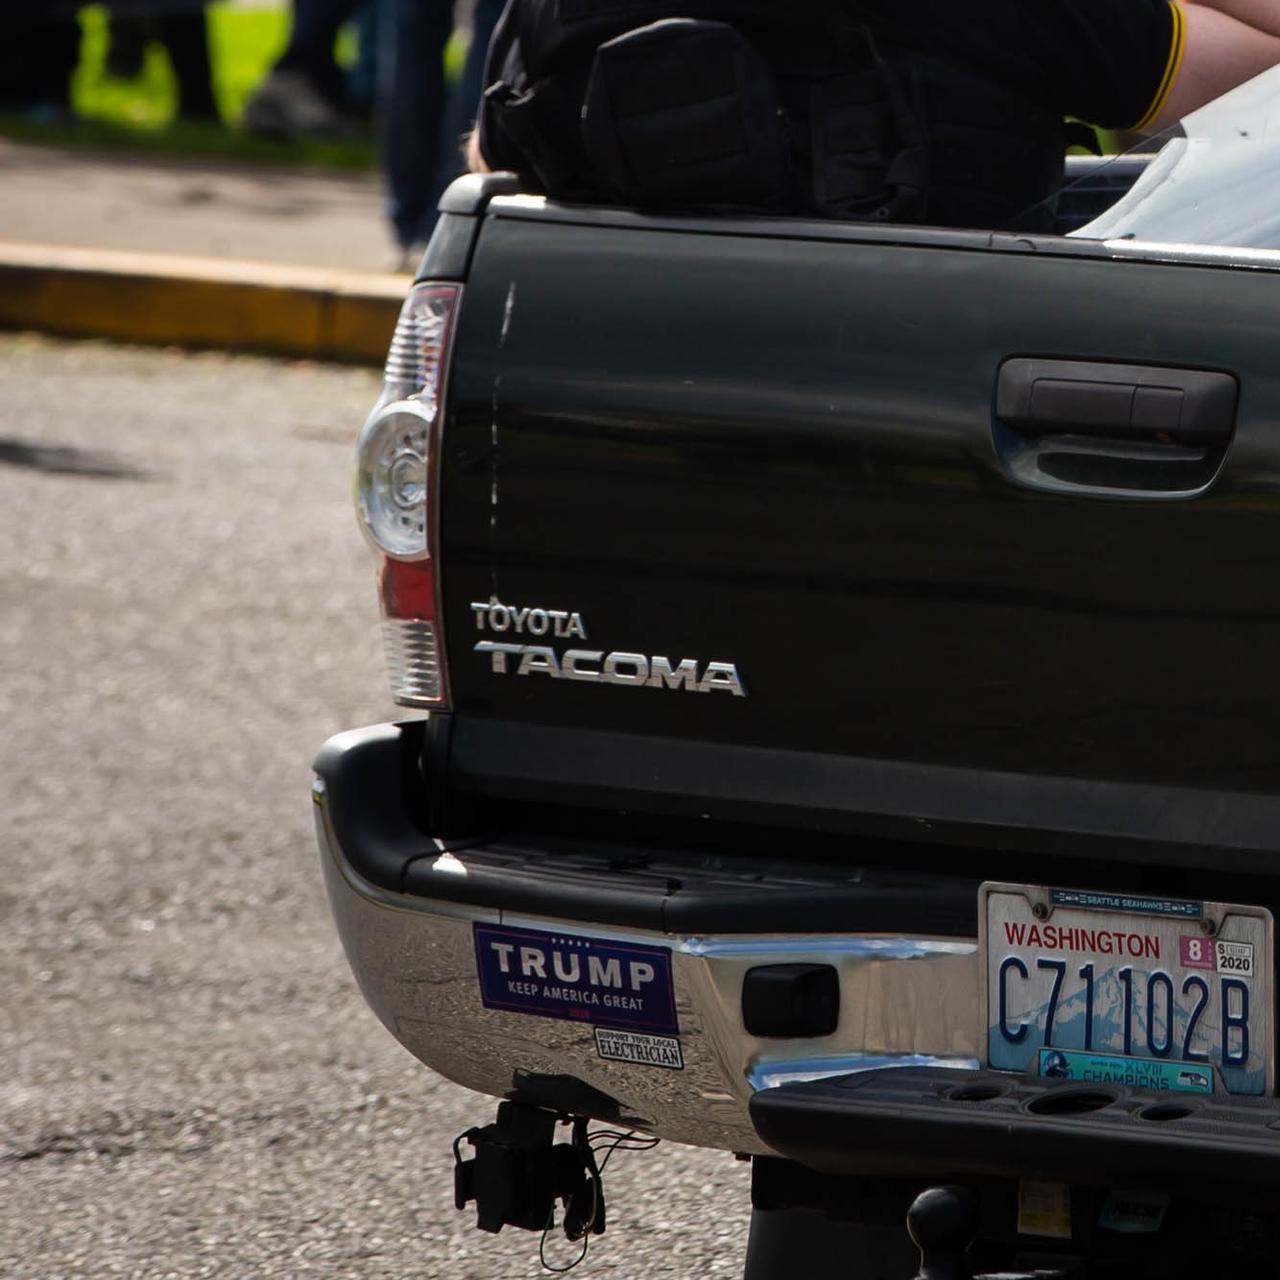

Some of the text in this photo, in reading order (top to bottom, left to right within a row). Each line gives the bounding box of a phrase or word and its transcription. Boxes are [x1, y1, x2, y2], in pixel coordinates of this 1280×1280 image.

[471, 600, 587, 640] TOYOTA
[473, 640, 747, 697] TACOMA
[1087, 896, 1164, 910] SEATTLE SEAHAWKS
[1003, 921, 1161, 960] WASHINGTON
[1189, 939, 1202, 961] 8
[490, 942, 655, 991] TRUMP
[1220, 956, 1250, 971] 2020
[508, 980, 644, 1011] KEEP AMERICA GREAT
[999, 956, 1250, 1067] C71102B
[600, 1040, 680, 1066] ELECTRICIAN
[653, 1038, 677, 1049] LOCAL
[1083, 1070, 1170, 1090] CHAMPIONS
[1124, 1060, 1163, 1077] XLVIII
